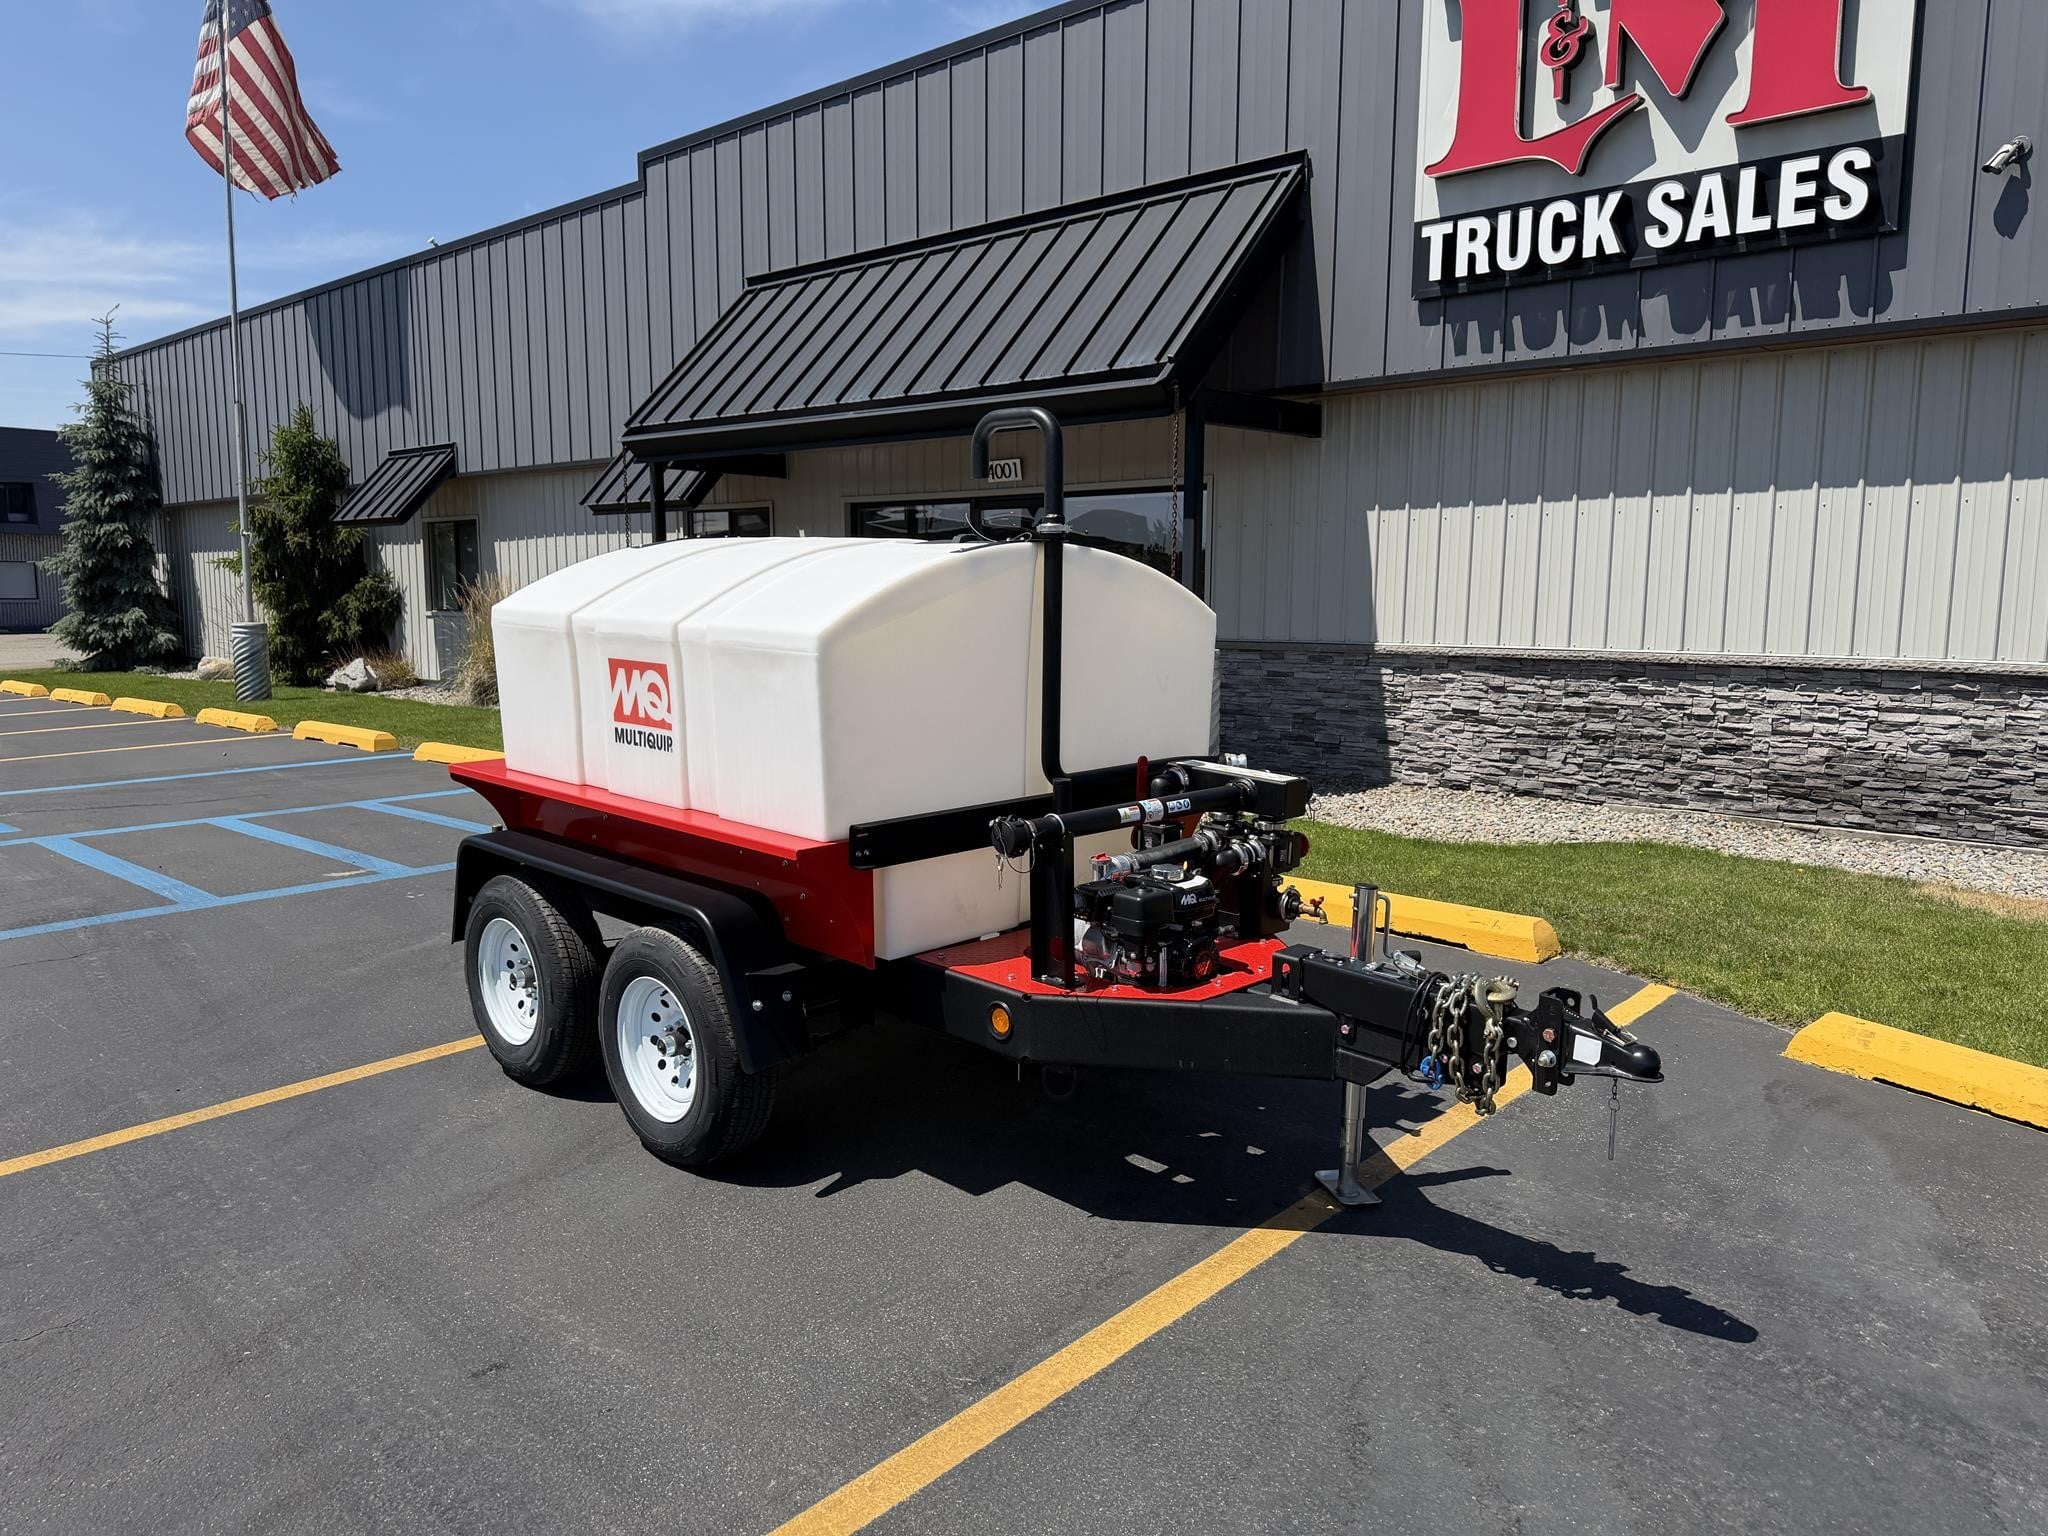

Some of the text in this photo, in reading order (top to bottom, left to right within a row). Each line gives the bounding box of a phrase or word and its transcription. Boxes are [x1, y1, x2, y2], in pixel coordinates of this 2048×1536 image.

[1421, 147, 1872, 282] TRUCK SALES
[609, 667, 672, 723] MQ
[614, 726, 673, 753] MULTIQUIP
